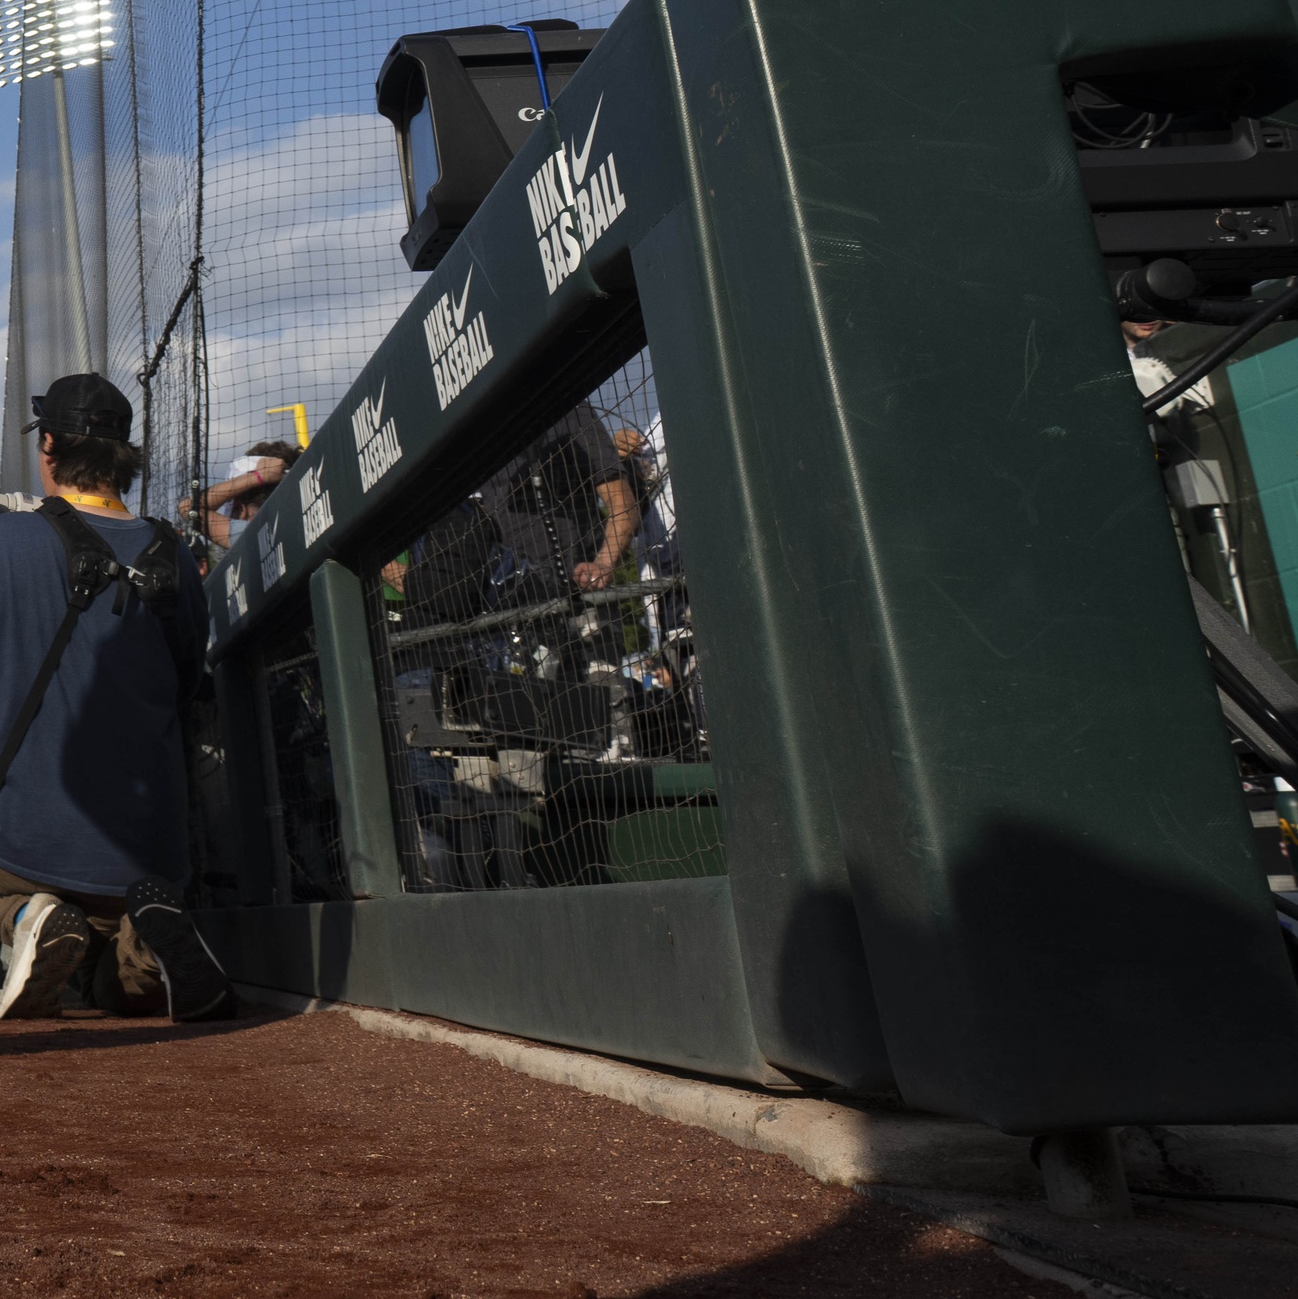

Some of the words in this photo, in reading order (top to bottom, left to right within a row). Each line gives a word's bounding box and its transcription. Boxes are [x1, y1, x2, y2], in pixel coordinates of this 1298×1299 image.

[526, 141, 575, 239] NIKE
[538, 152, 627, 296] BASBALL
[423, 292, 456, 364] NIKE
[433, 311, 494, 411] BASEBALL
[352, 396, 374, 453] NIKE
[358, 416, 403, 494] BASEBALL
